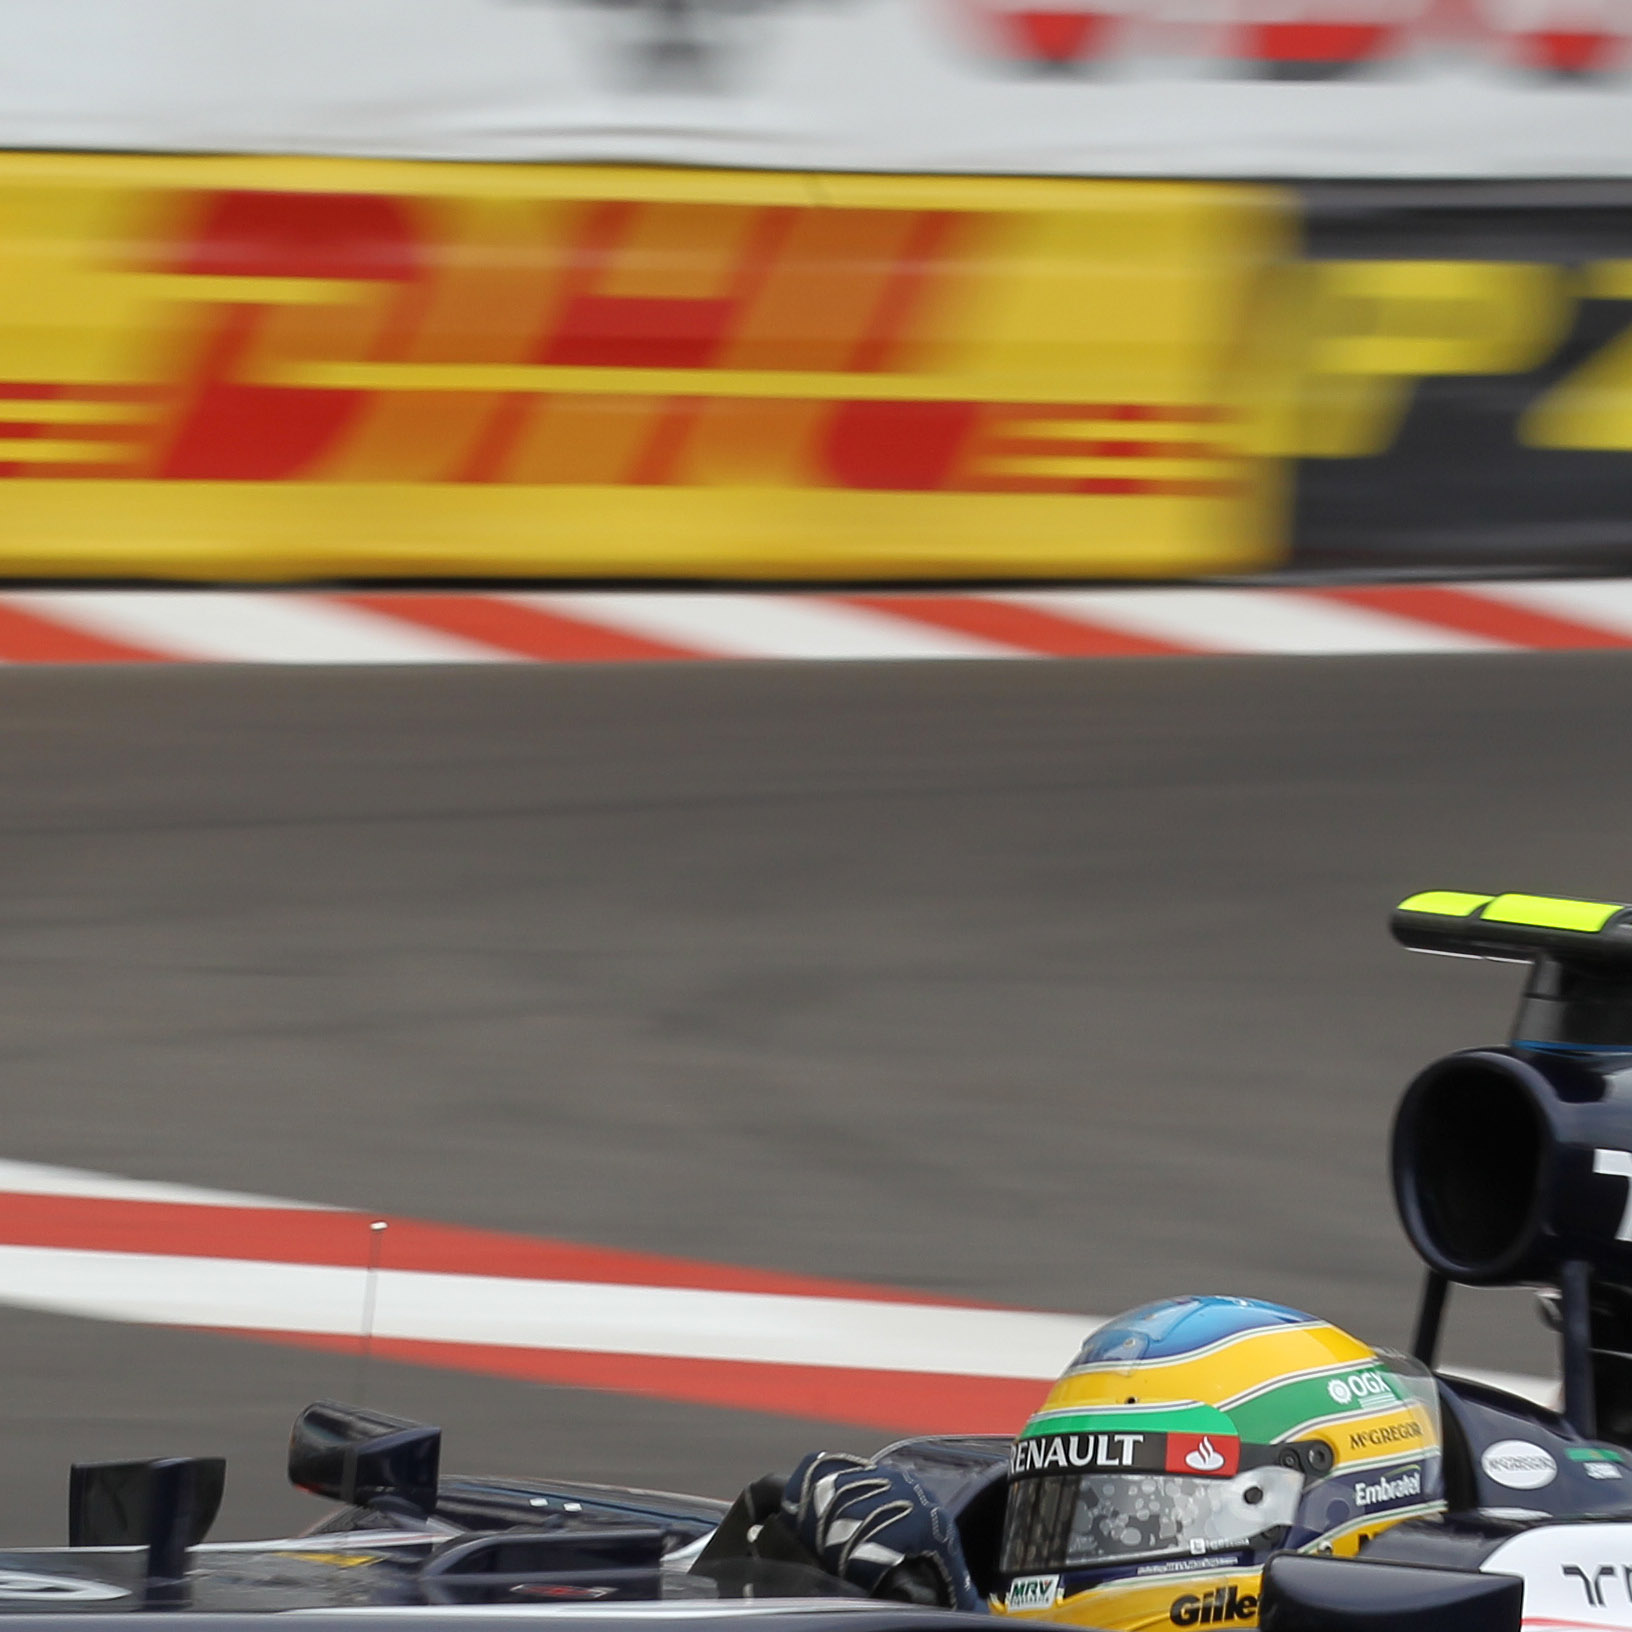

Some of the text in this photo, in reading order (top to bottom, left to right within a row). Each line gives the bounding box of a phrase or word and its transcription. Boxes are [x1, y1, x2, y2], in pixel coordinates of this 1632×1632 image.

[143, 188, 1008, 494] DHL
[1348, 1371, 1392, 1397] OGX
[1008, 1434, 1144, 1475] RENAULT
[1355, 1471, 1422, 1507] Embratel
[1012, 1579, 1054, 1597] MRV
[1169, 1585, 1260, 1627] Gille
